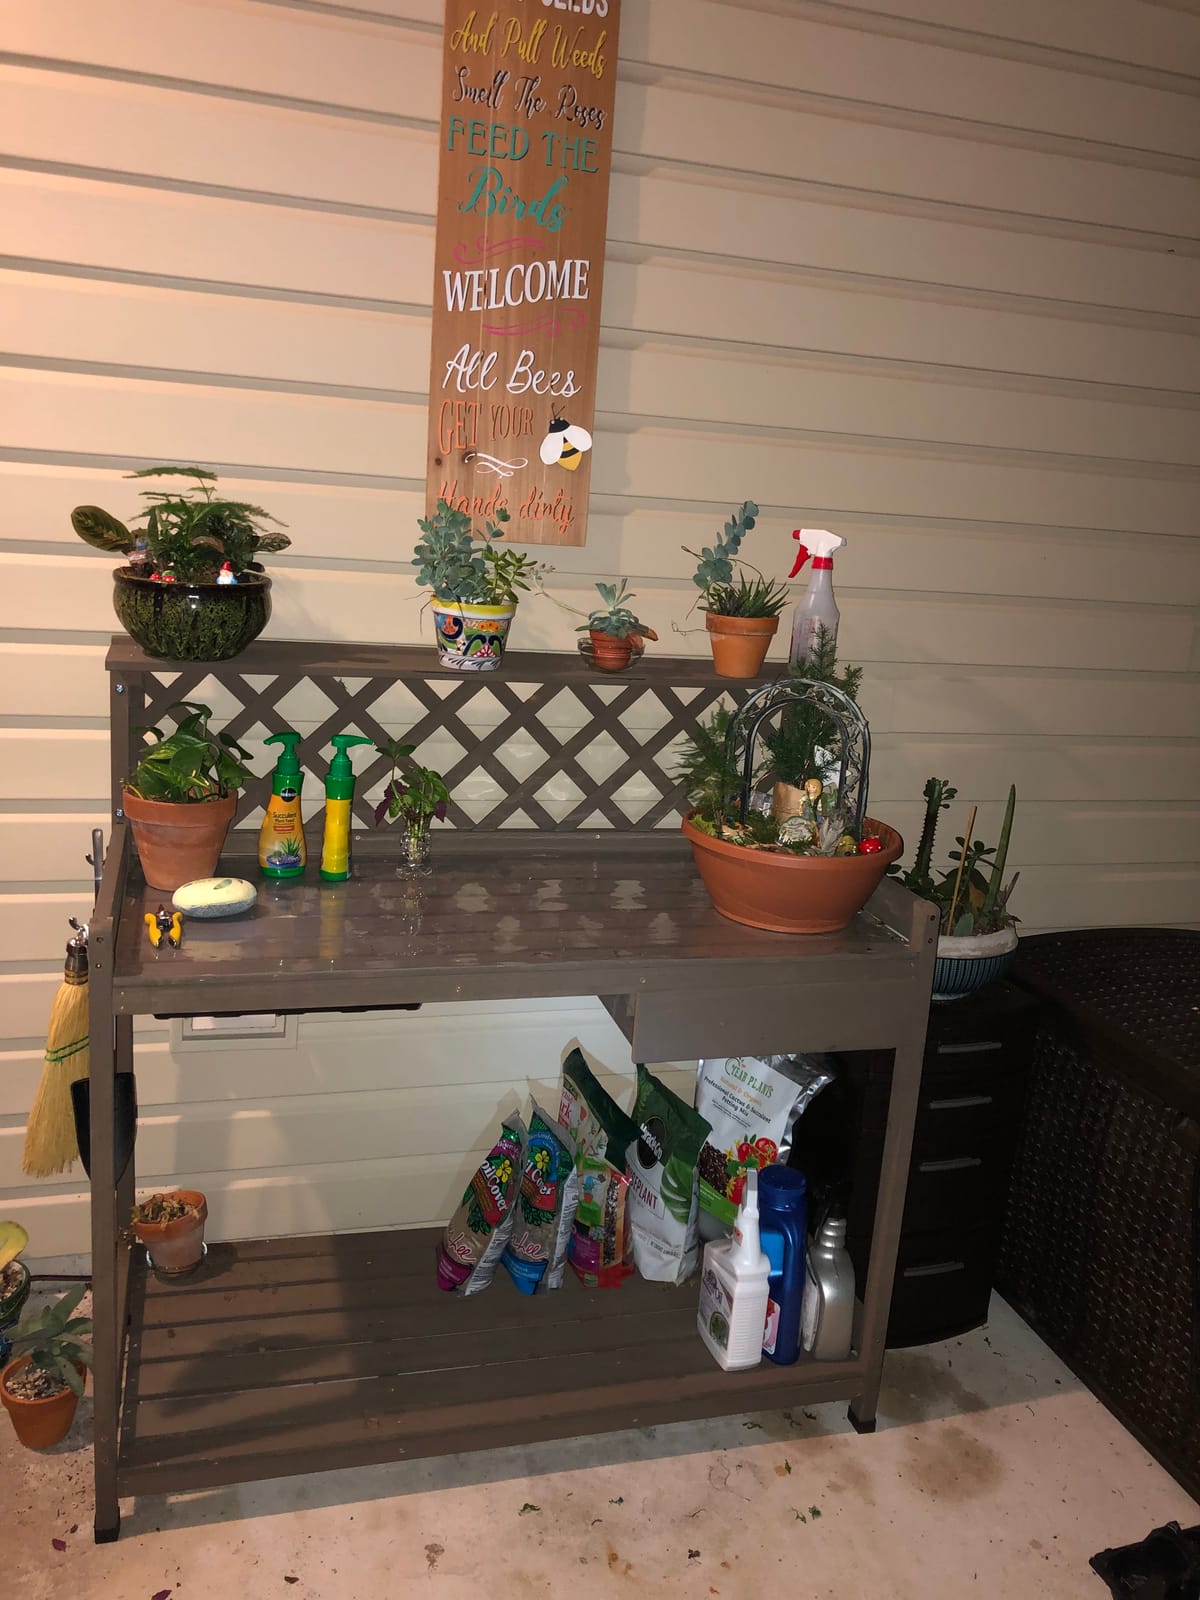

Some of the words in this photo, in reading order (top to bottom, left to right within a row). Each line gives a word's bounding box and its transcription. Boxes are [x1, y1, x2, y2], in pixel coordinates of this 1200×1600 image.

[450, 10, 497, 56] And
[501, 17, 547, 64] Pull
[551, 24, 607, 79] Weeds
[452, 66, 510, 110] Smell
[514, 76, 547, 119] The
[554, 84, 607, 130] Roses
[447, 116, 529, 161] FEED
[541, 130, 600, 173] THE
[457, 165, 571, 232] Birds
[442, 259, 590, 312] WELCOME
[442, 344, 498, 393] All
[506, 350, 581, 398] Bees
[439, 399, 482, 455] GET
[489, 404, 534, 441] YOUR
[437, 479, 508, 518] Hands
[519, 485, 575, 534] dirty
[480, 1159, 497, 1181] oil
[487, 1175, 508, 1212] Cover
